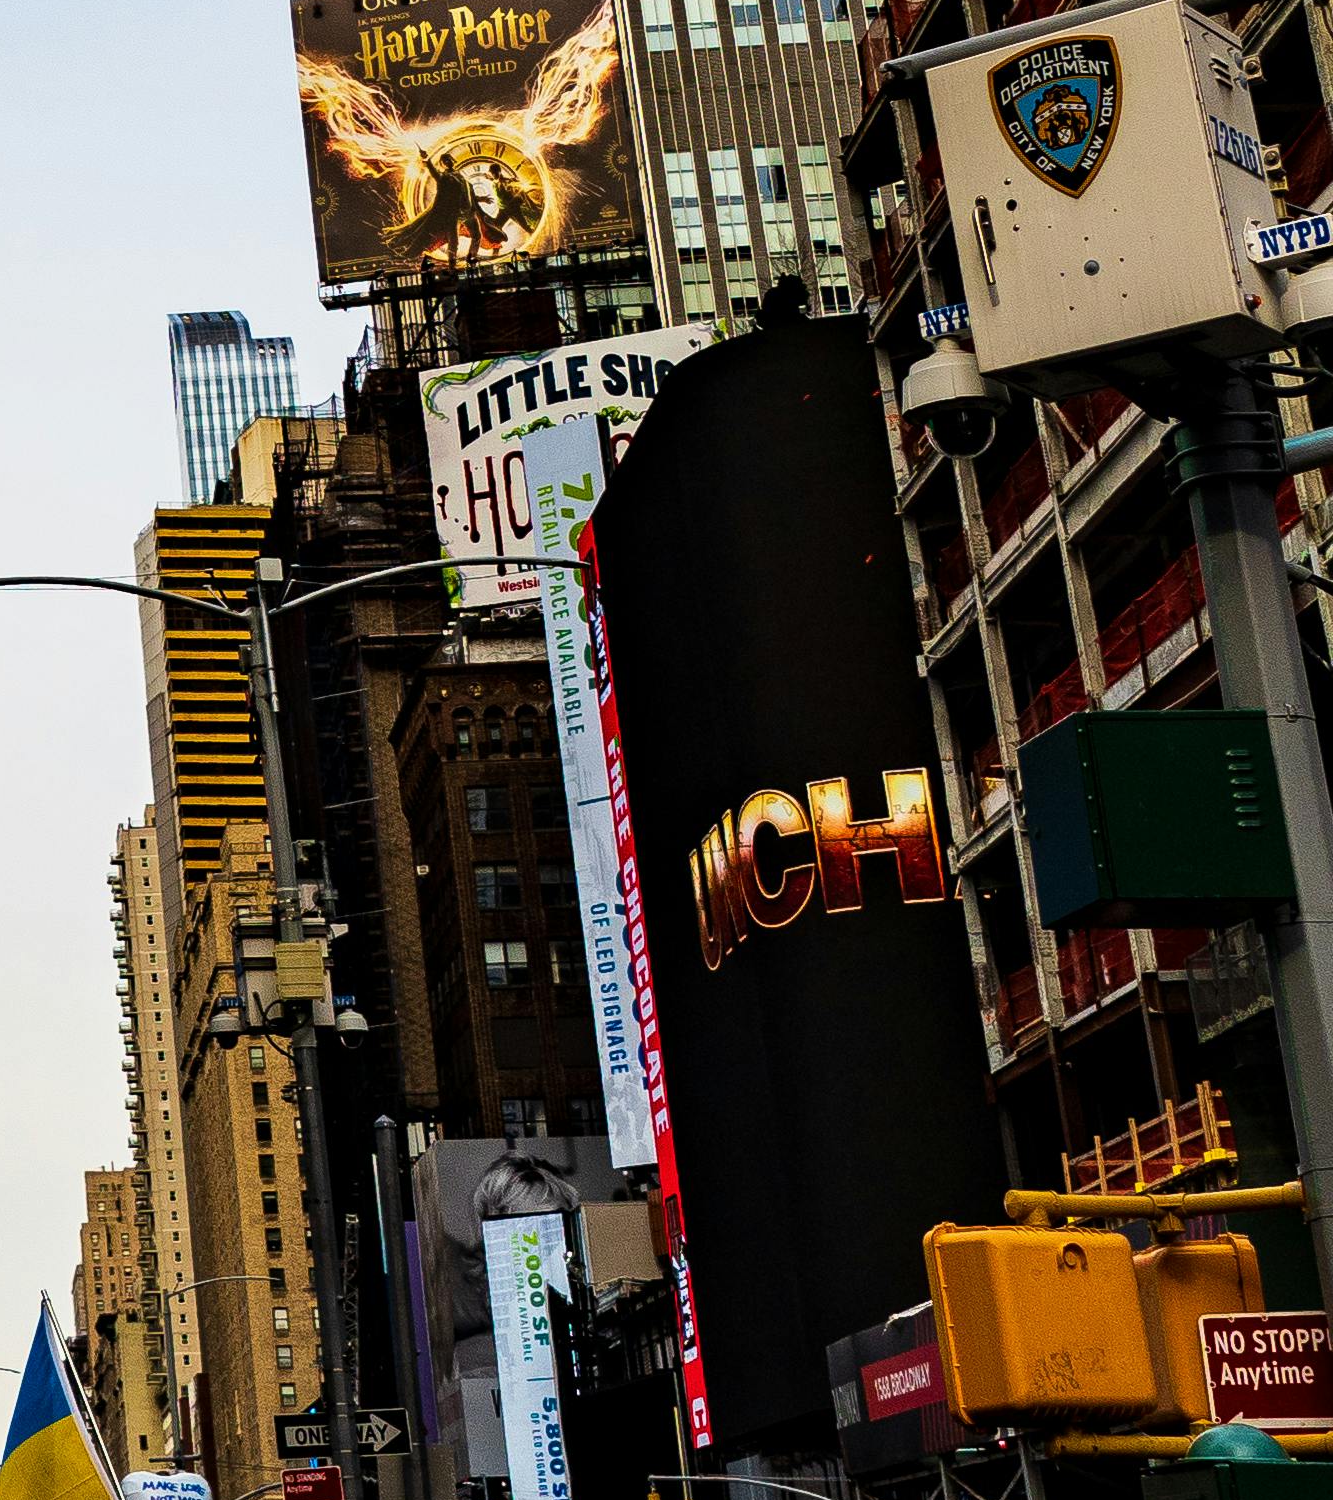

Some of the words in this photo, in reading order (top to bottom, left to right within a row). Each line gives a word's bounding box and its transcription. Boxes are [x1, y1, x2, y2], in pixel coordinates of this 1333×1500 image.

[355, 21, 451, 85] Harry
[450, 3, 554, 78] Potter
[1018, 43, 1084, 76] POLICE
[399, 67, 462, 90] CURSED
[466, 58, 519, 79] CHILD
[1000, 60, 1111, 106] DEPARTMENT
[1008, 120, 1035, 159] CITY
[1035, 153, 1056, 174] OF
[1081, 133, 1103, 171] NEW
[1097, 85, 1116, 133] YORK
[1257, 214, 1331, 260] NYPD
[455, 353, 593, 450] LITTLE
[536, 483, 561, 553] RETAIL
[555, 628, 585, 736] AVAILABLE
[589, 902, 610, 928] OF
[595, 939, 616, 975] LED
[606, 737, 632, 848] FREE
[619, 856, 671, 1140] CHOCOLATE
[600, 981, 631, 1078] SIGNAGE
[521, 1231, 545, 1309] 7,000
[531, 1315, 552, 1347] SF
[1212, 1330, 1246, 1355] NO
[890, 1363, 932, 1397] BROADWAY
[1220, 1361, 1315, 1391] Anytime
[295, 1424, 330, 1445] ONE
[541, 1396, 566, 1476] 5,800
[142, 1481, 178, 1493] MAKE
[294, 1471, 327, 1484] STANDING
